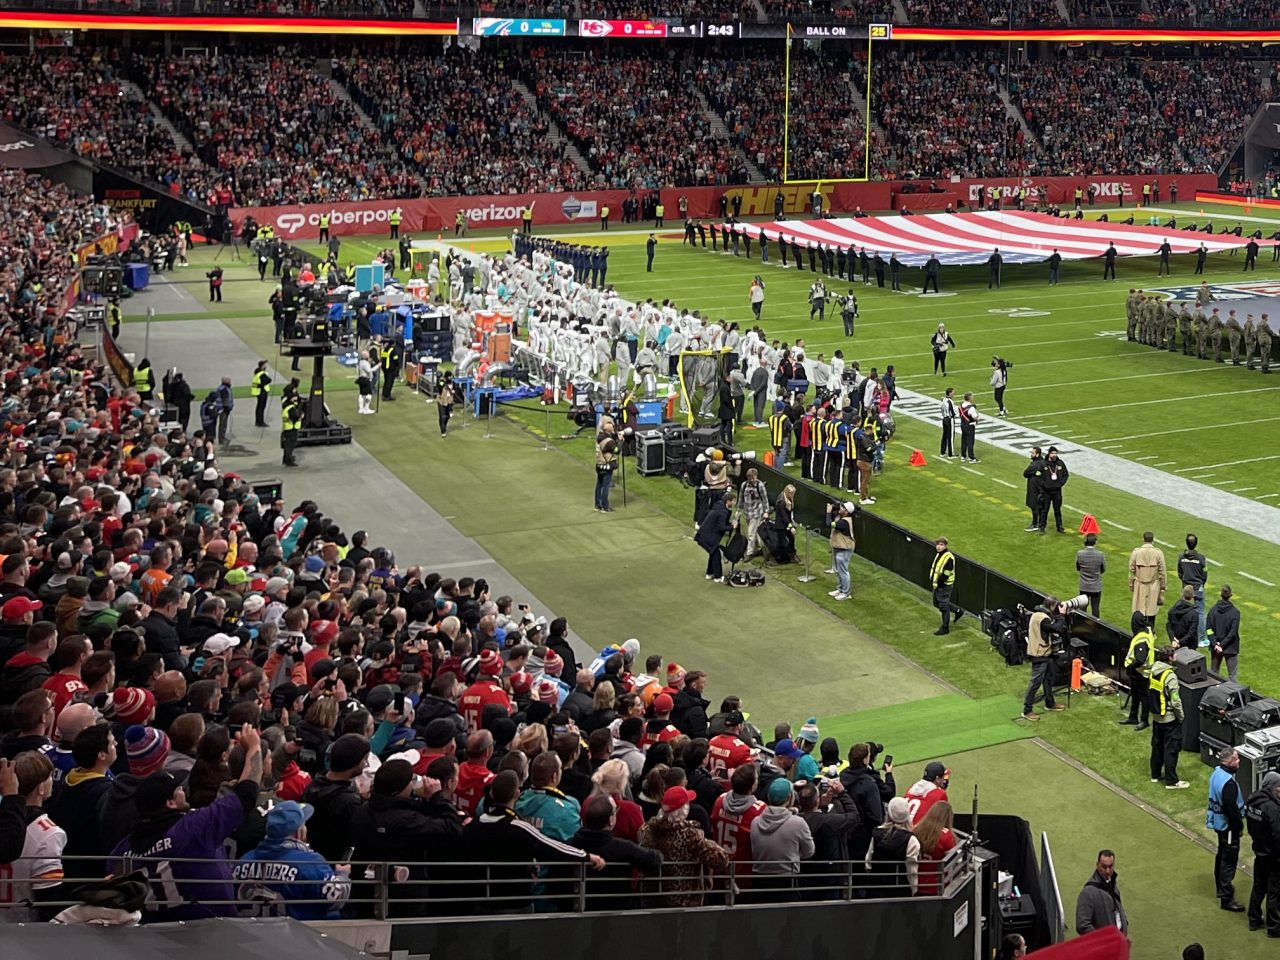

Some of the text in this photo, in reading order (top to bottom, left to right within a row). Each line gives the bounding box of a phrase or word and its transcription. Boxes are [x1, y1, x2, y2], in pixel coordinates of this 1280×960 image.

[520, 21, 529, 33] 0
[624, 23, 632, 34] 0
[689, 24, 696, 35] 1
[707, 24, 734, 36] 2:43
[806, 26, 846, 36] BALL ON
[871, 26, 886, 36] 25
[986, 185, 1041, 200] SRAUS
[716, 820, 740, 855] 15
[240, 862, 299, 882] SANDERS
